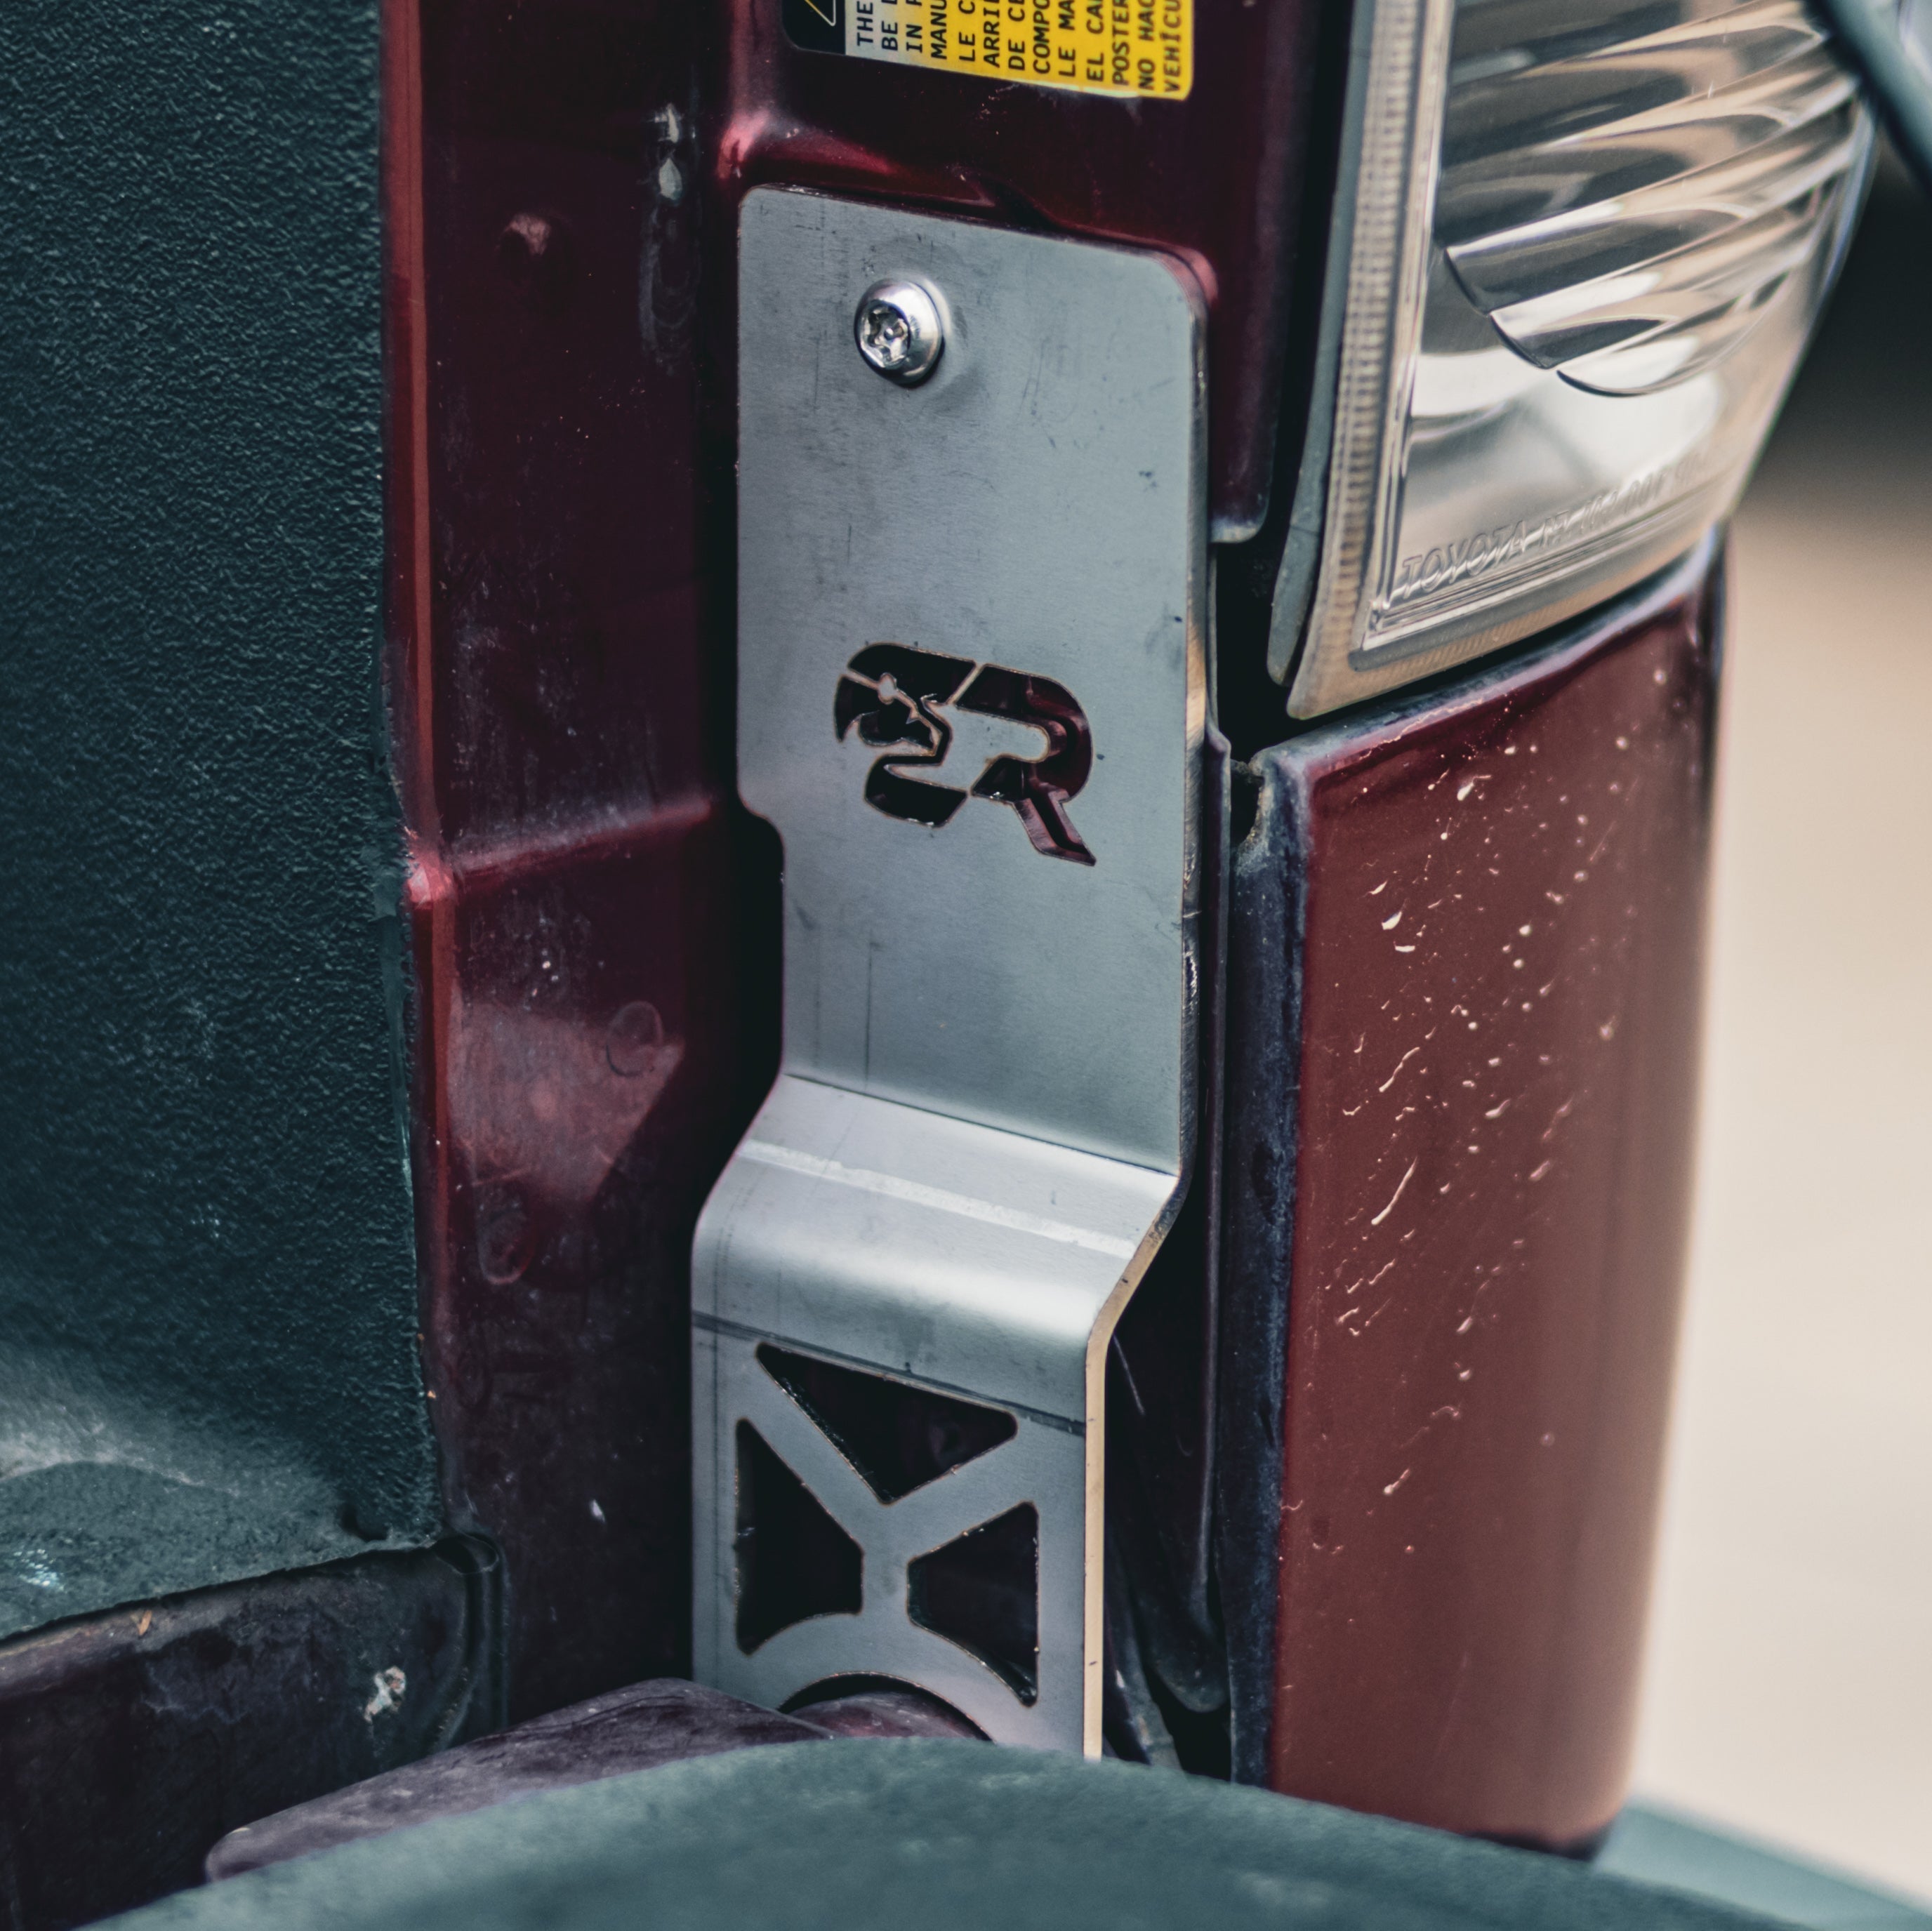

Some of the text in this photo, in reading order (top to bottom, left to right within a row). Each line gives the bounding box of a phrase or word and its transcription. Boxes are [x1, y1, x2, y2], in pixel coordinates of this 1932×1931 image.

[856, 1, 873, 46] THE
[882, 20, 898, 51] BE
[906, 25, 922, 53] IN
[958, 32, 975, 62] LE
[1008, 39, 1025, 70] DE
[1059, 46, 1076, 77] LE
[1087, 52, 1104, 81] EL
[1137, 58, 1156, 91] NO
[1400, 520, 1528, 599] TOYOTA
